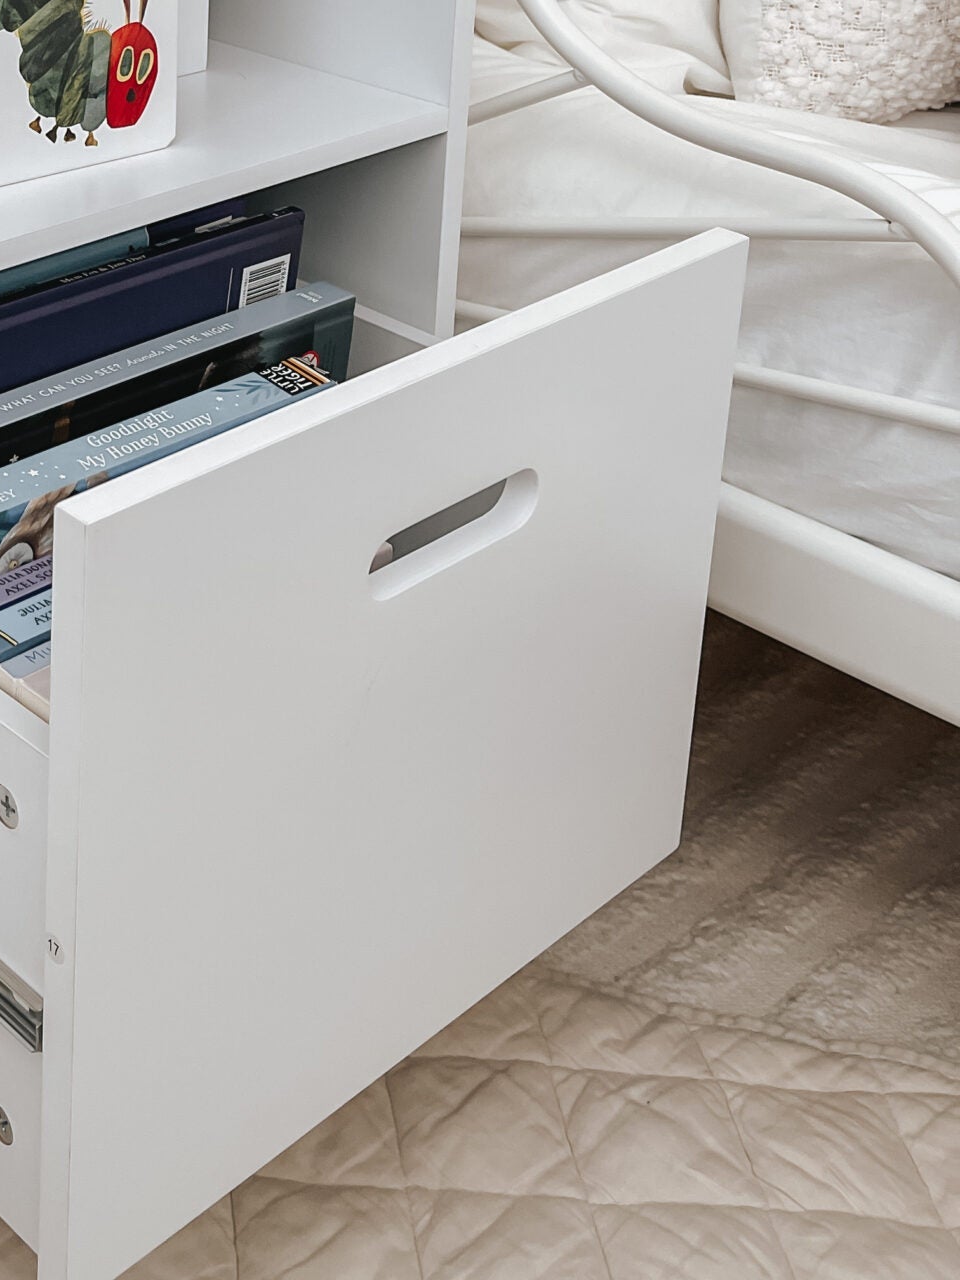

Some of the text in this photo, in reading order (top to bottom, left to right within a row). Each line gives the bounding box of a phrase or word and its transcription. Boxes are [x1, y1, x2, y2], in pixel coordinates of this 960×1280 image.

[38, 384, 66, 398] CAN
[66, 374, 93, 388] YOU
[94, 363, 121, 377] SEE?
[126, 349, 165, 367] Animals
[162, 343, 177, 352] IN
[177, 335, 201, 346] THE
[201, 323, 234, 338] NIGHT
[260, 368, 300, 393] LITTLE
[271, 363, 312, 390] TIGER
[76, 412, 213, 471] My Honey Bunny
[87, 409, 175, 448] Goodnight
[22, 558, 53, 575] DONA
[5, 569, 53, 596] AXEL SC
[48, 939, 59, 956] 17
